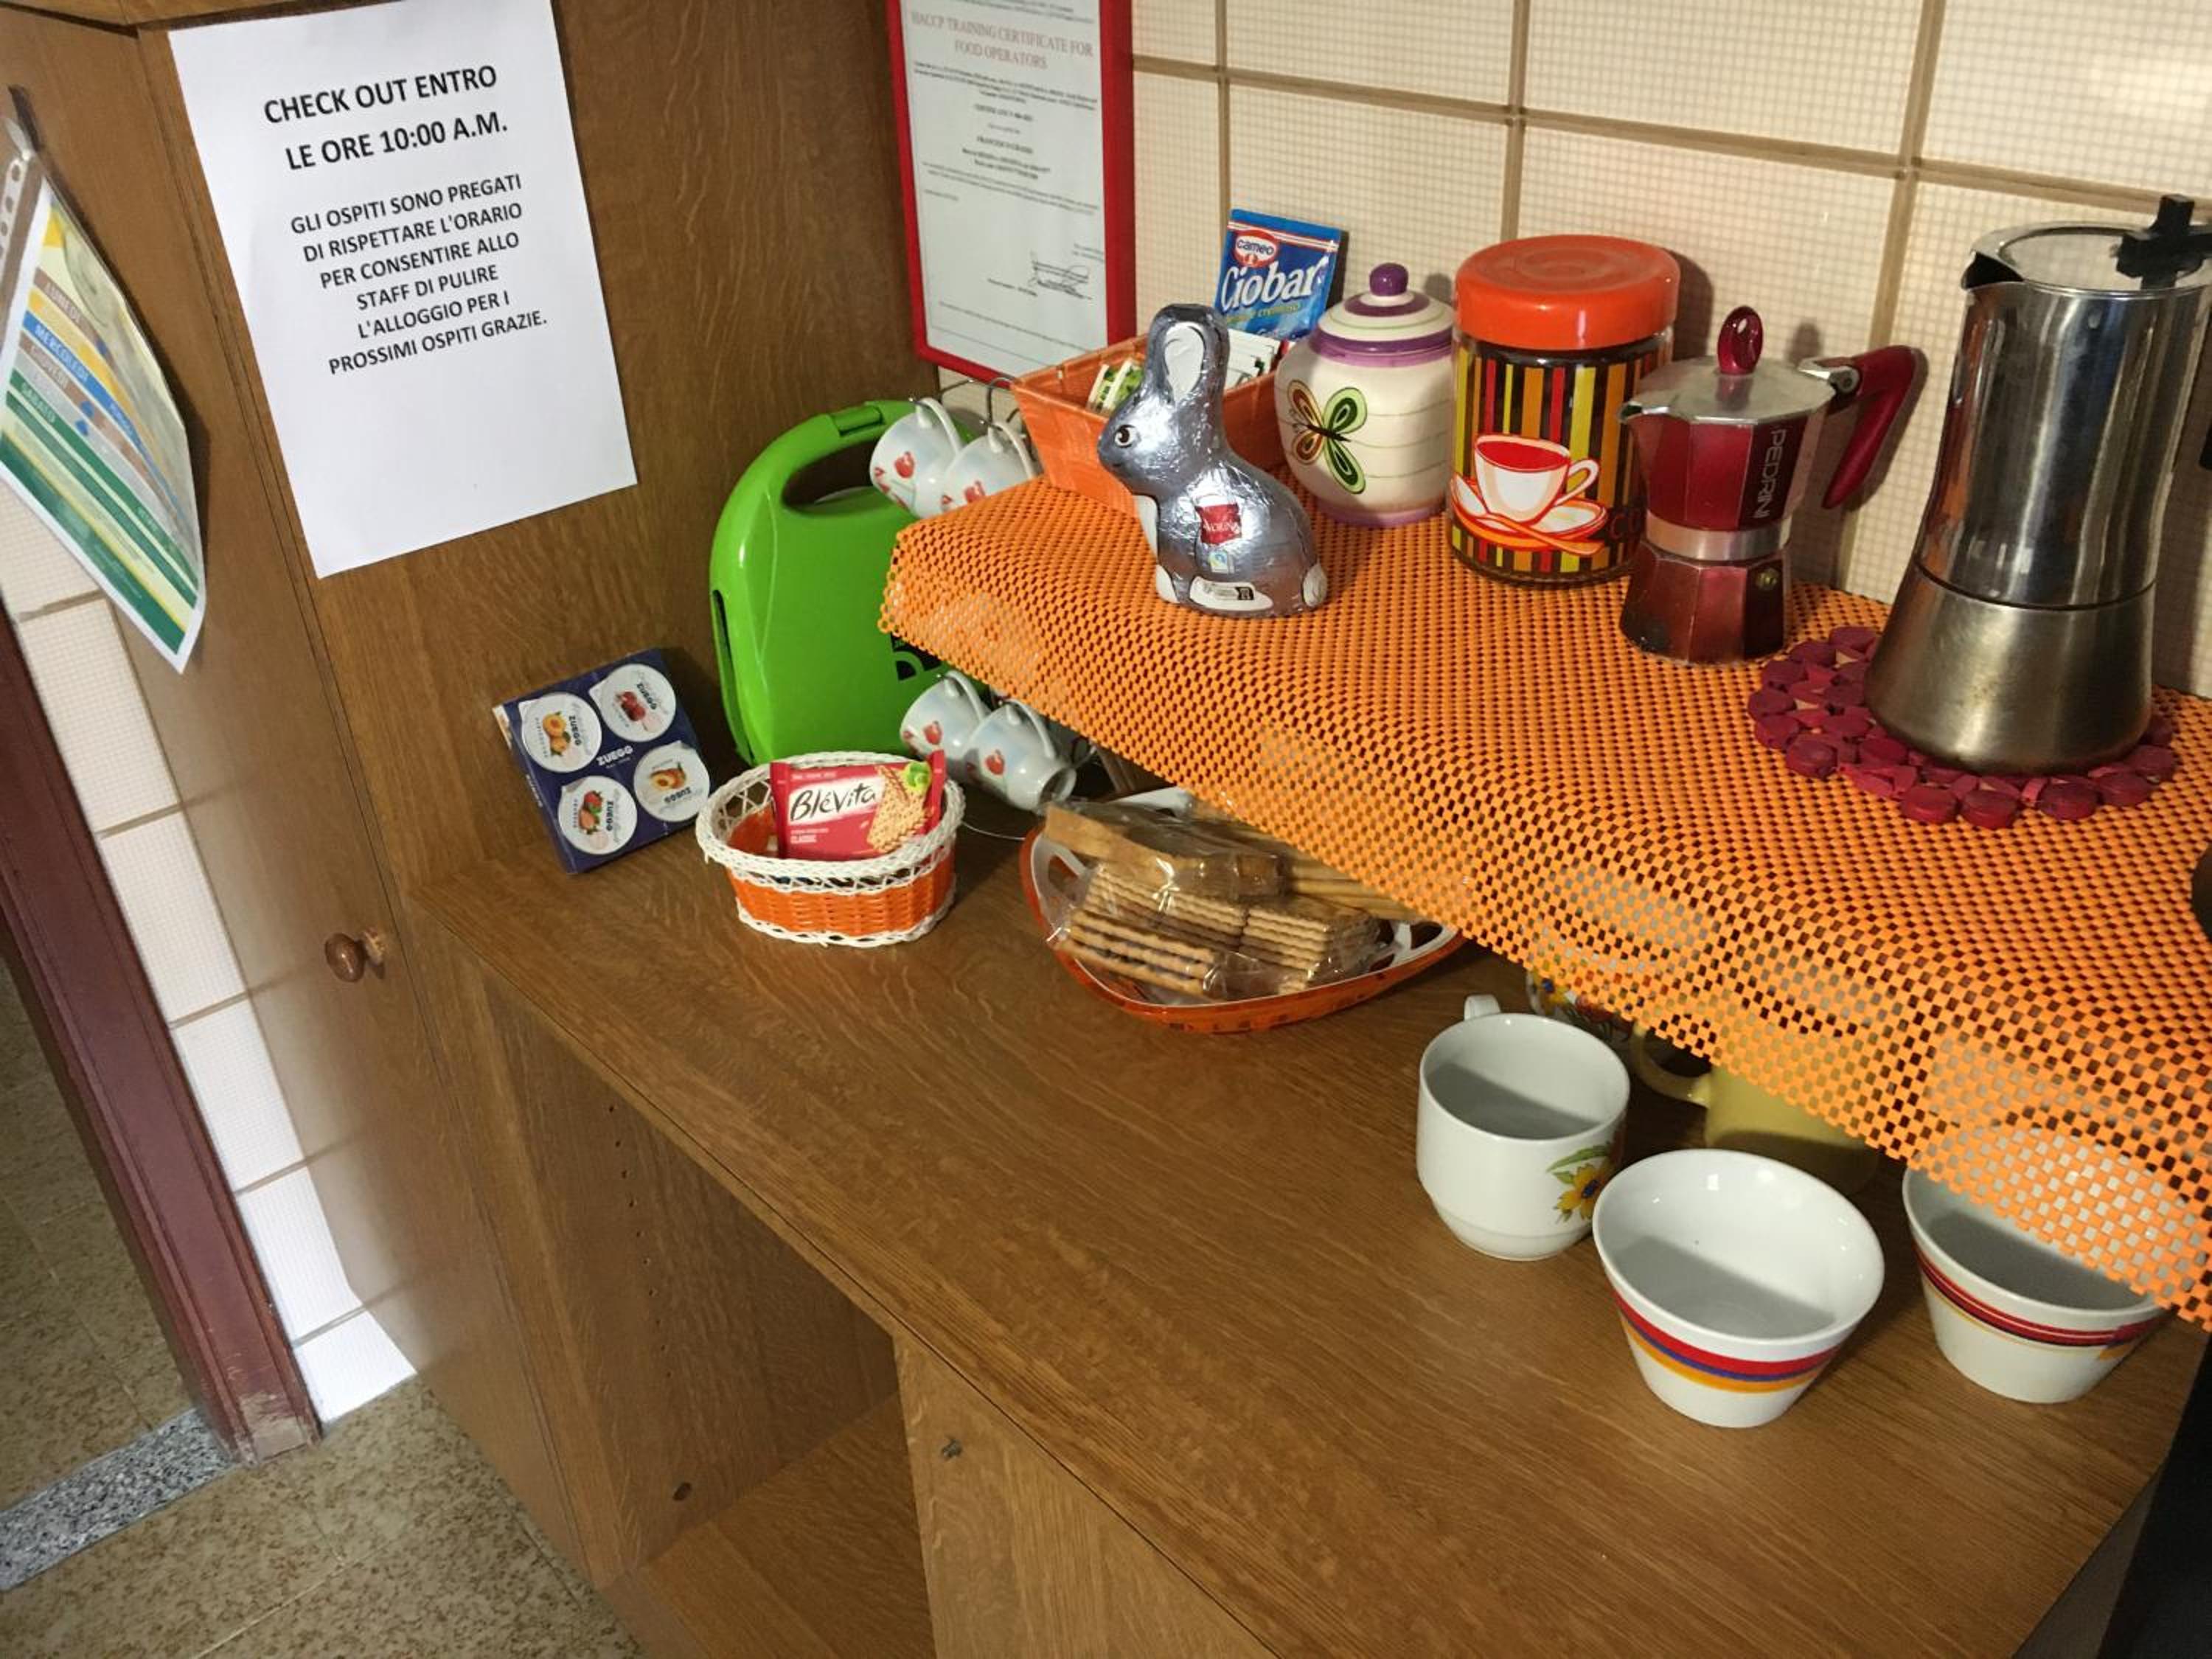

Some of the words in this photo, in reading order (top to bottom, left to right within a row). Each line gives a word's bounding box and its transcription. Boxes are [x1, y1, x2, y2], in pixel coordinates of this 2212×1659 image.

[955, 39, 983, 58] FOOD
[1070, 41, 1094, 58] FOR
[264, 88, 350, 124] CHECK
[355, 79, 407, 108] OUT
[414, 65, 497, 99] ENTRO
[286, 144, 316, 170] LE
[321, 133, 375, 163] ORE
[379, 121, 446, 153] 10:00
[453, 111, 508, 140] A.M.
[291, 213, 321, 234] GLI
[326, 200, 387, 227] OSPITI
[389, 189, 443, 215] SONO
[447, 173, 522, 203] PREGATI
[303, 243, 325, 262] DI
[328, 220, 437, 257] RISPETTARE
[439, 202, 523, 234] L'ORARIO
[320, 267, 357, 289] PER
[360, 242, 473, 280] CONSENTIRE
[476, 232, 521, 255] ALLO
[1237, 238, 1275, 256] cameo
[356, 283, 411, 310] STAFF
[414, 279, 434, 297] DI
[438, 264, 499, 292] PULIRE
[1220, 255, 1330, 314] Ciobar
[328, 338, 418, 375] PROSSIMI
[421, 324, 478, 352] OSPITI
[481, 310, 548, 338] GRAZIE.
[358, 301, 463, 339] L'ALLOGGIO
[467, 292, 501, 313] PER
[503, 290, 510, 306] I
